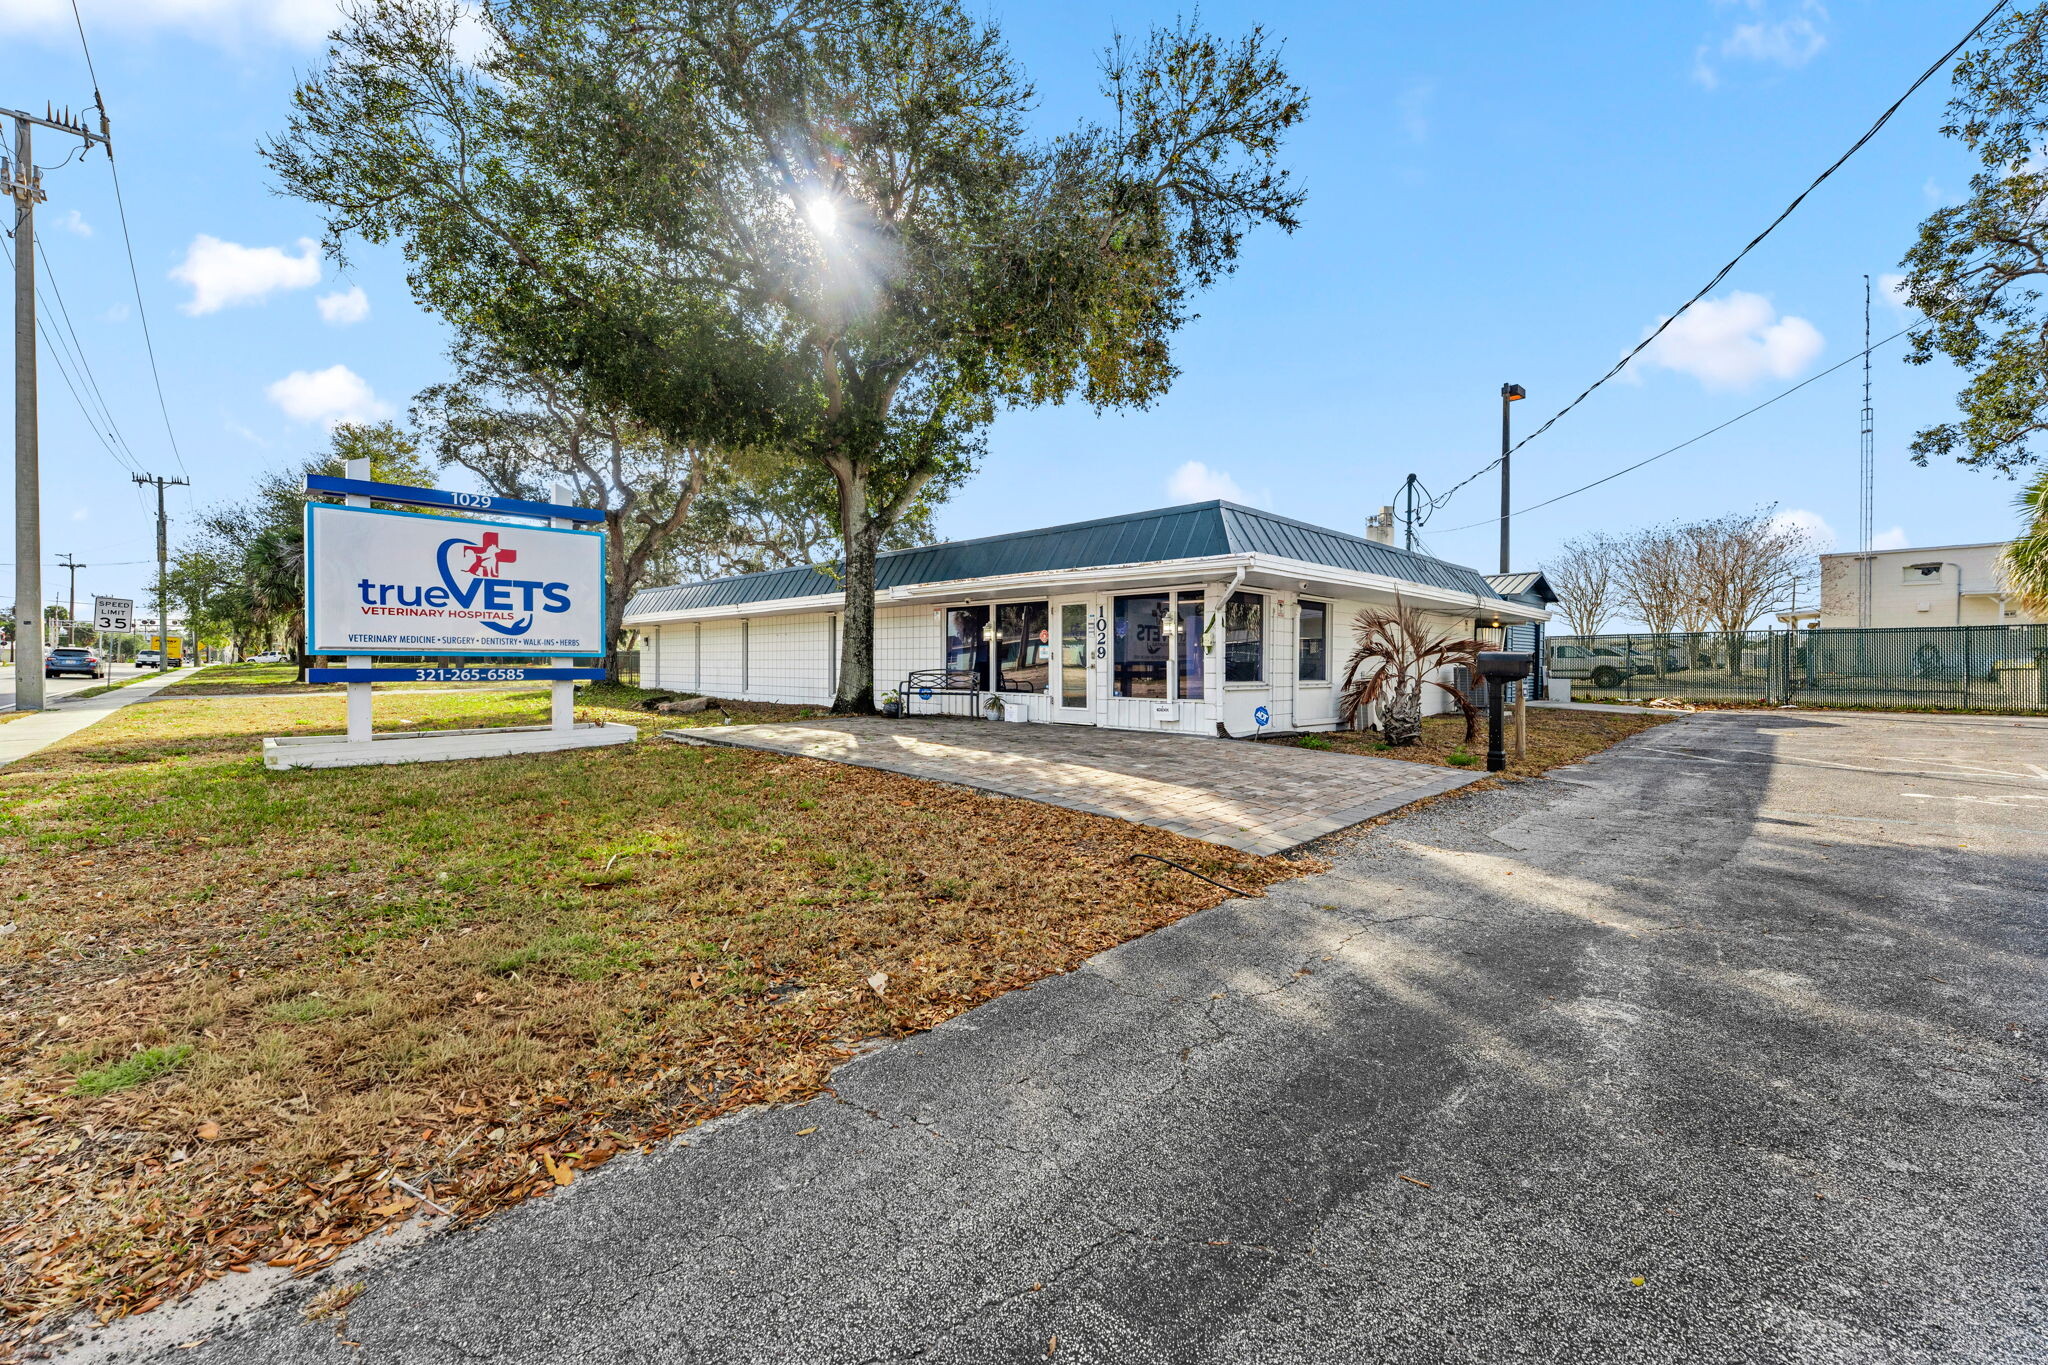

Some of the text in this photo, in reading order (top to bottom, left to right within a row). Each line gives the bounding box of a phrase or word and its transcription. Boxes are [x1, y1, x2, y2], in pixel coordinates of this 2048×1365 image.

[451, 492, 492, 508] 1029
[98, 600, 130, 609] SPEED
[361, 606, 515, 621] VETERINARY HOSPITALS
[99, 617, 127, 629] 35
[1096, 605, 1107, 659] 1029
[348, 633, 580, 647] VETERINARY MEDICINE SURGERY DENTISTRY WALK-INS HERBS
[415, 669, 525, 681] 321-265-6585
